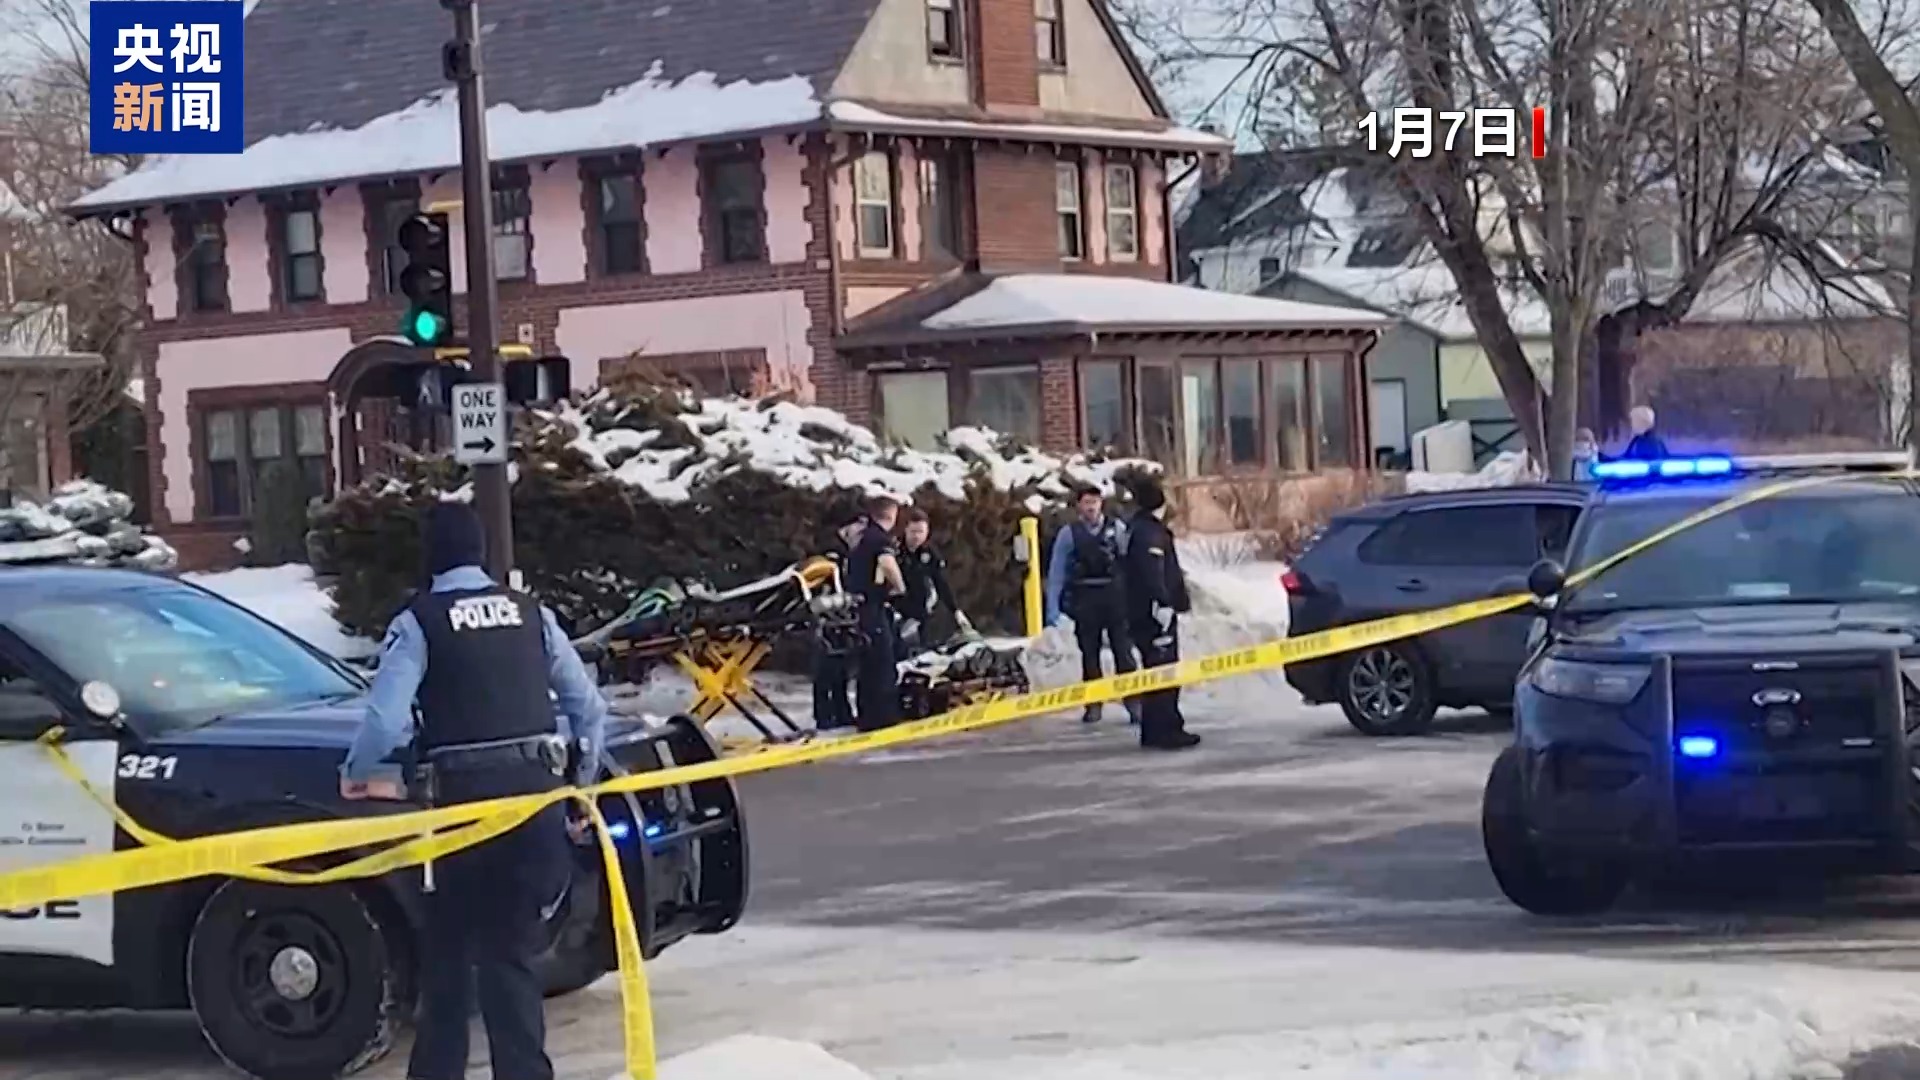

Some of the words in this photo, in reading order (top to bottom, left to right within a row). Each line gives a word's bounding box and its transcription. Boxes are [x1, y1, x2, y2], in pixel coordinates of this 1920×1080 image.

[460, 390, 497, 409] ONE
[459, 411, 497, 429] WAY
[448, 600, 523, 631] POLICE
[117, 754, 179, 780] 321
